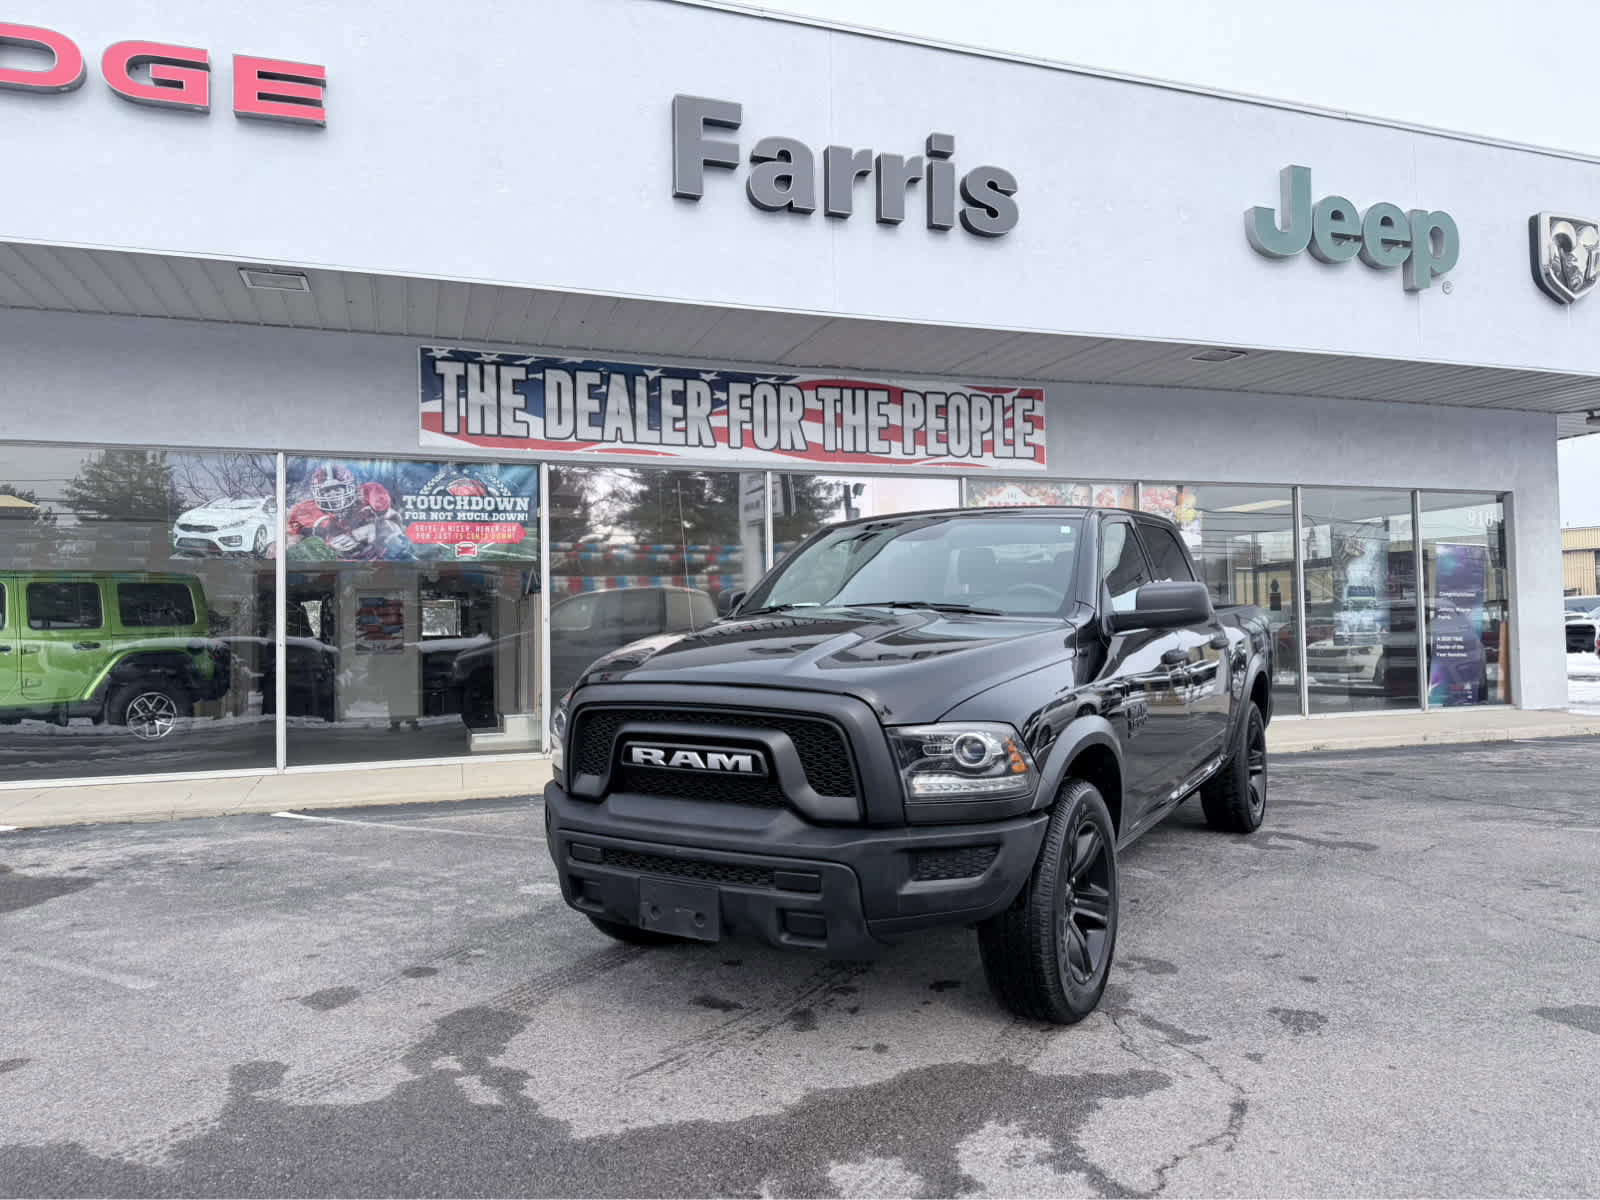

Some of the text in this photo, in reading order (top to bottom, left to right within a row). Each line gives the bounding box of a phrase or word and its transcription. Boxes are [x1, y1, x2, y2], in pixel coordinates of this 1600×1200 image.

[672, 93, 1020, 238] Farris
[1244, 164, 1461, 293] Jeep
[434, 359, 1036, 460] THE DEALER FOR THE PEOPLE
[402, 495, 530, 511] TOUCHDOWN
[404, 511, 528, 521] FOR NOT MUCH DOWN!
[631, 746, 753, 773] RAM
